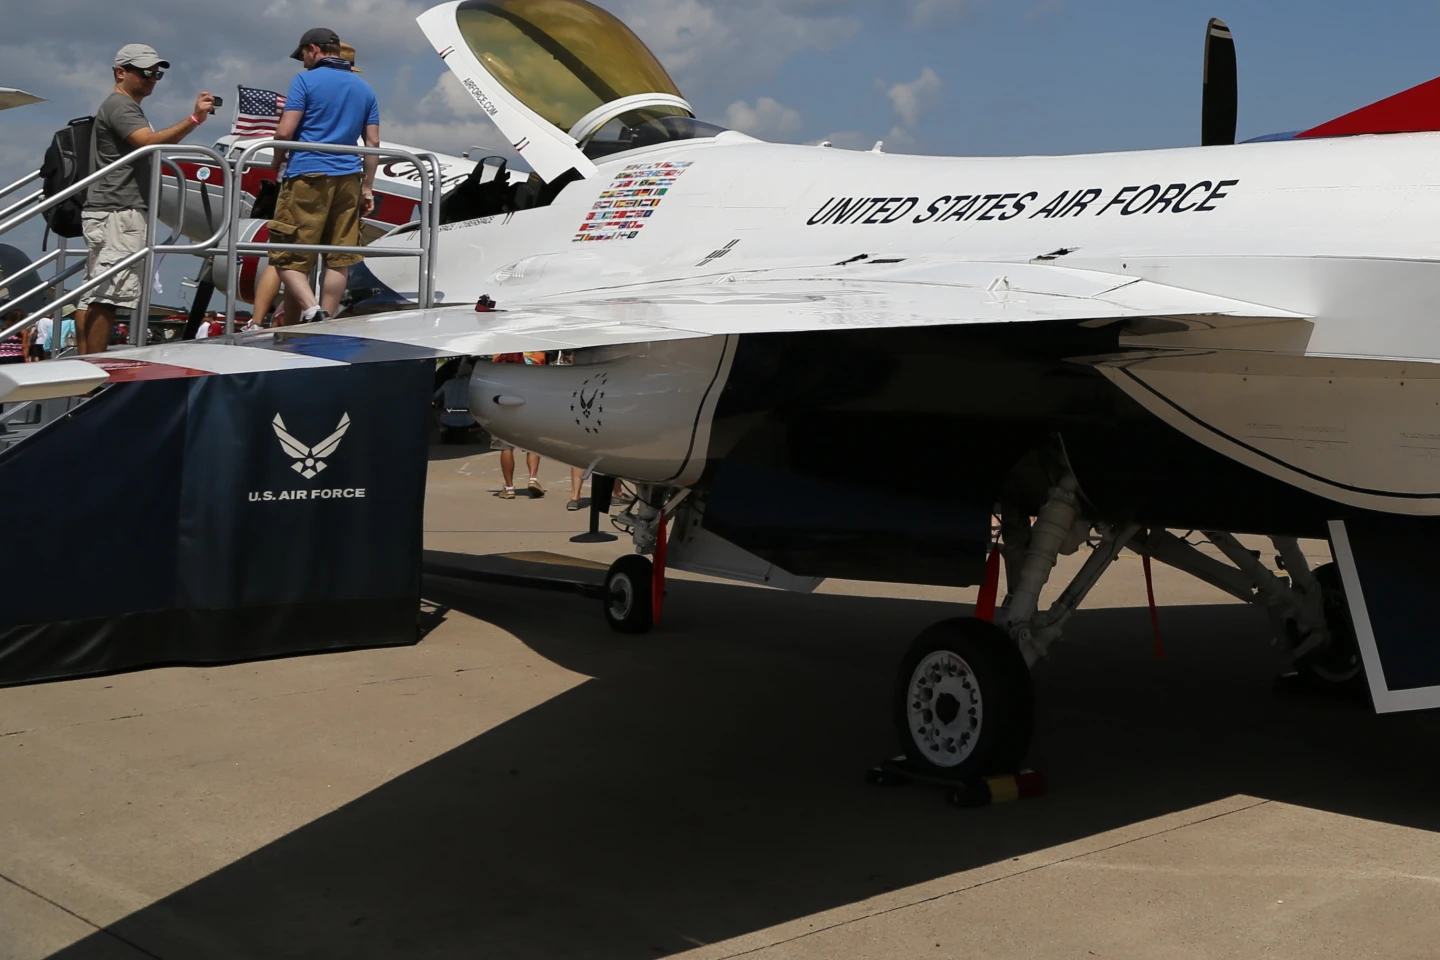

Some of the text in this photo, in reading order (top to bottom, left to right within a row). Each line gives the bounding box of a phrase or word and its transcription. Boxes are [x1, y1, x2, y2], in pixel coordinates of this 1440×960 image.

[462, 77, 499, 117] AIRFORCE.COM
[806, 179, 1239, 225] UNITED STATES AIR FORCE
[248, 488, 366, 501] U.S. AIR FORCE
